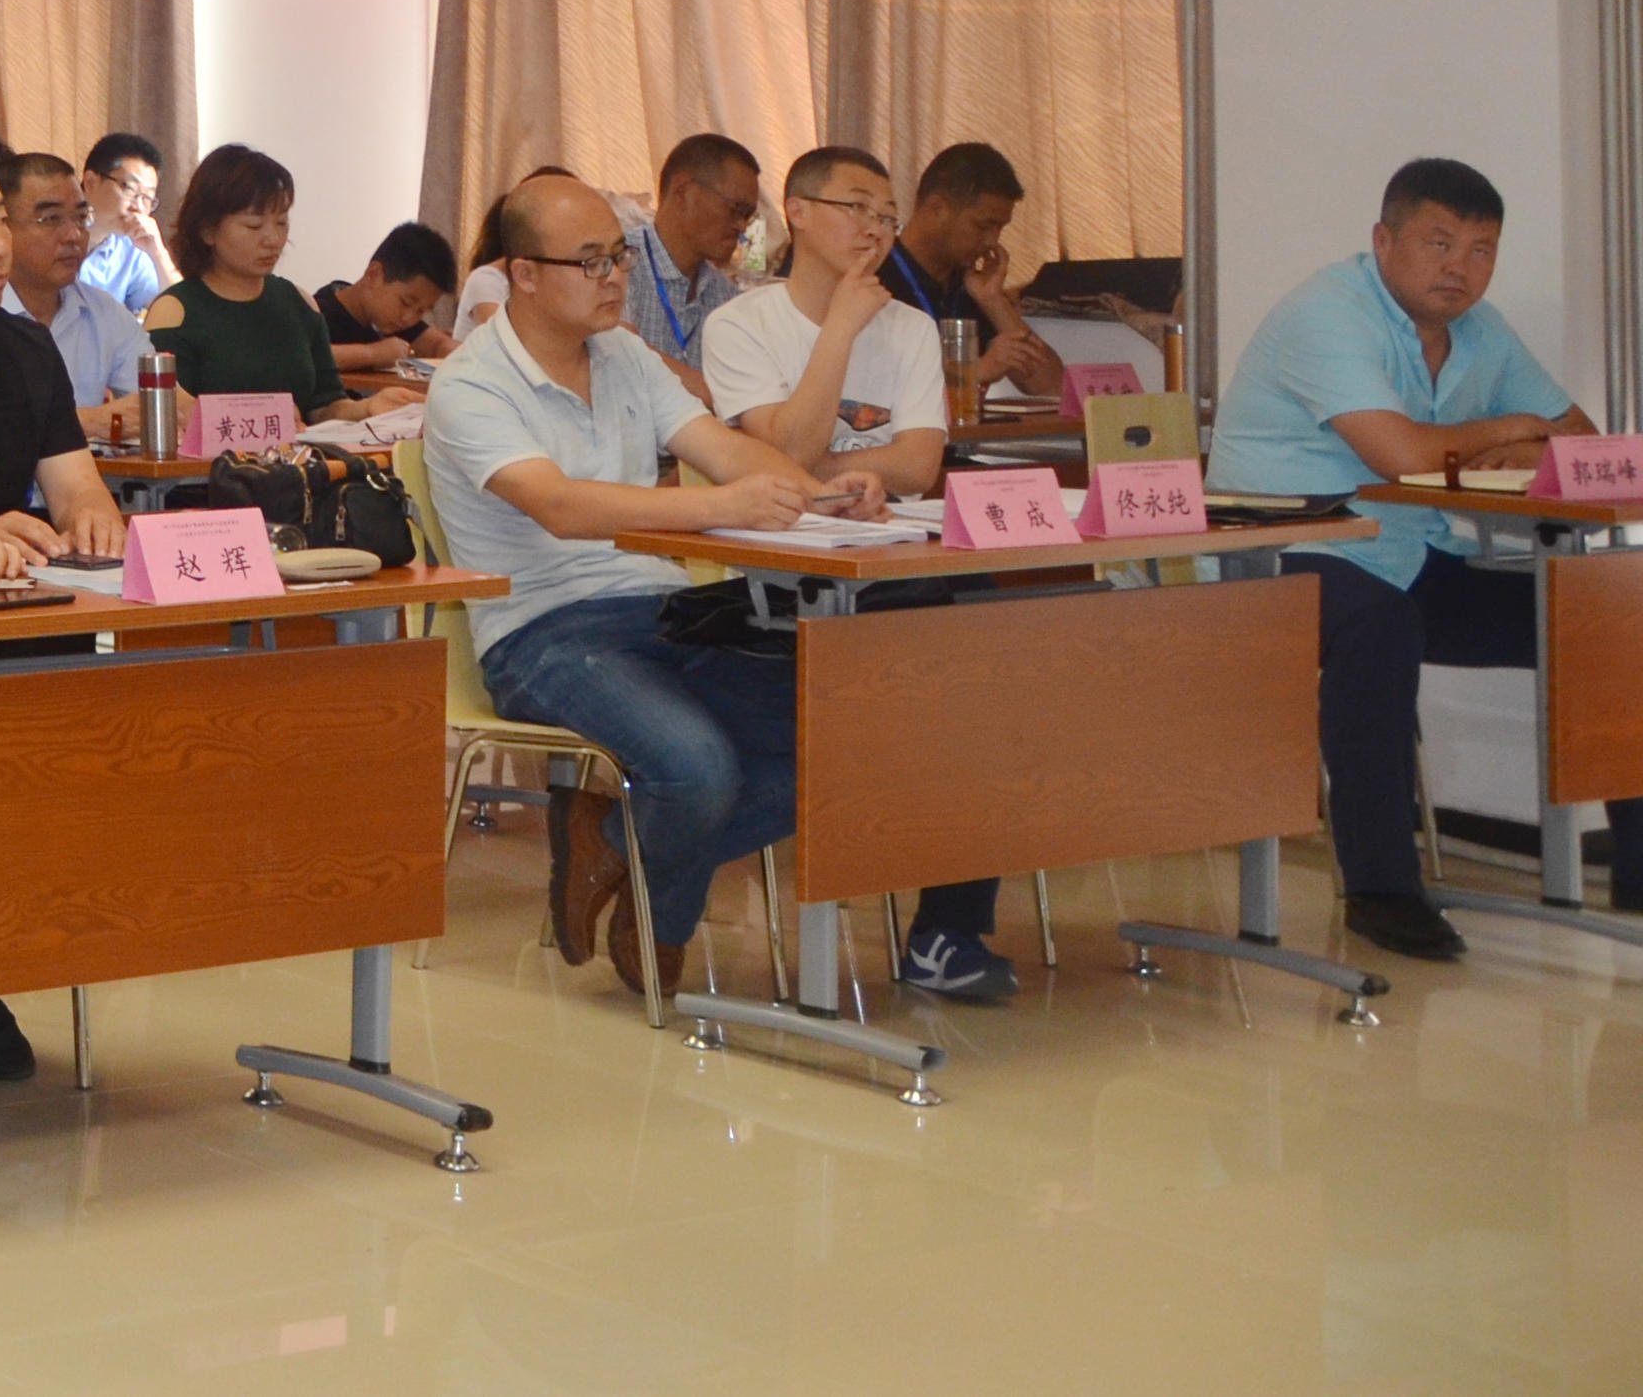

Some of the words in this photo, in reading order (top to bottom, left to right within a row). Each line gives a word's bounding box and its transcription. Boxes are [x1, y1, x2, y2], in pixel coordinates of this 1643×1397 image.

[216, 414, 281, 442] 黄汉周
[984, 500, 1055, 533] 曹成
[1116, 487, 1191, 519] 佟永纯
[174, 545, 252, 582] 赵辉
